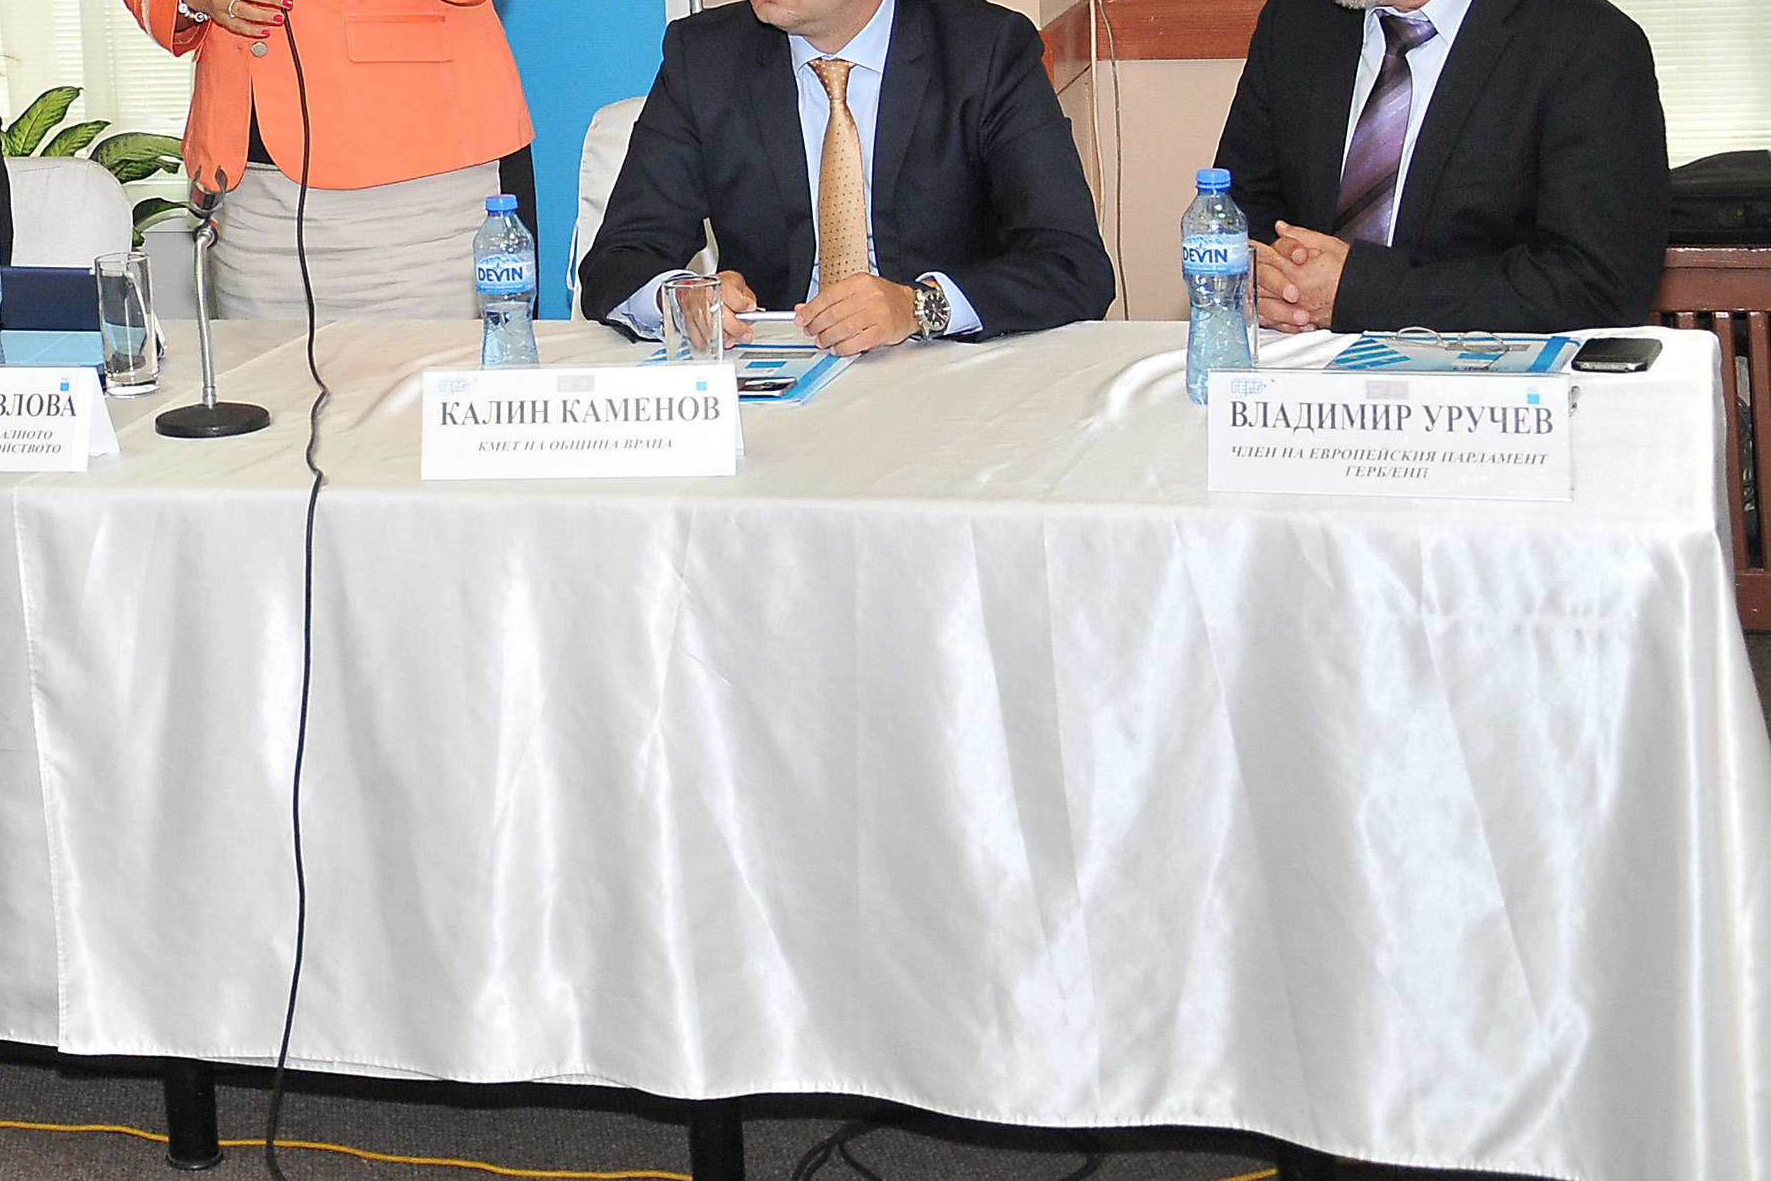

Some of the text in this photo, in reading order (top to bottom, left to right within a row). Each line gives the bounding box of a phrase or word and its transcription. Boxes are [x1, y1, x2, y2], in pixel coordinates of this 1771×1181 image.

[1183, 246, 1228, 263] DEVIN
[478, 266, 523, 282] DEVIN
[440, 395, 721, 426] КАЛИН КАМЕНОВ
[1230, 400, 1554, 435] ВЛАДИМИР УРУЧЕВ
[478, 438, 673, 452] КМЕТ НА ОБЩИНА ВРАЦА
[1231, 446, 1549, 466] ЧЛЕН НА ЕВРОПЕЙСКИЯ ПАРЛАМЕНТ
[1345, 465, 1429, 479] ГЕРБ/ЕНП
